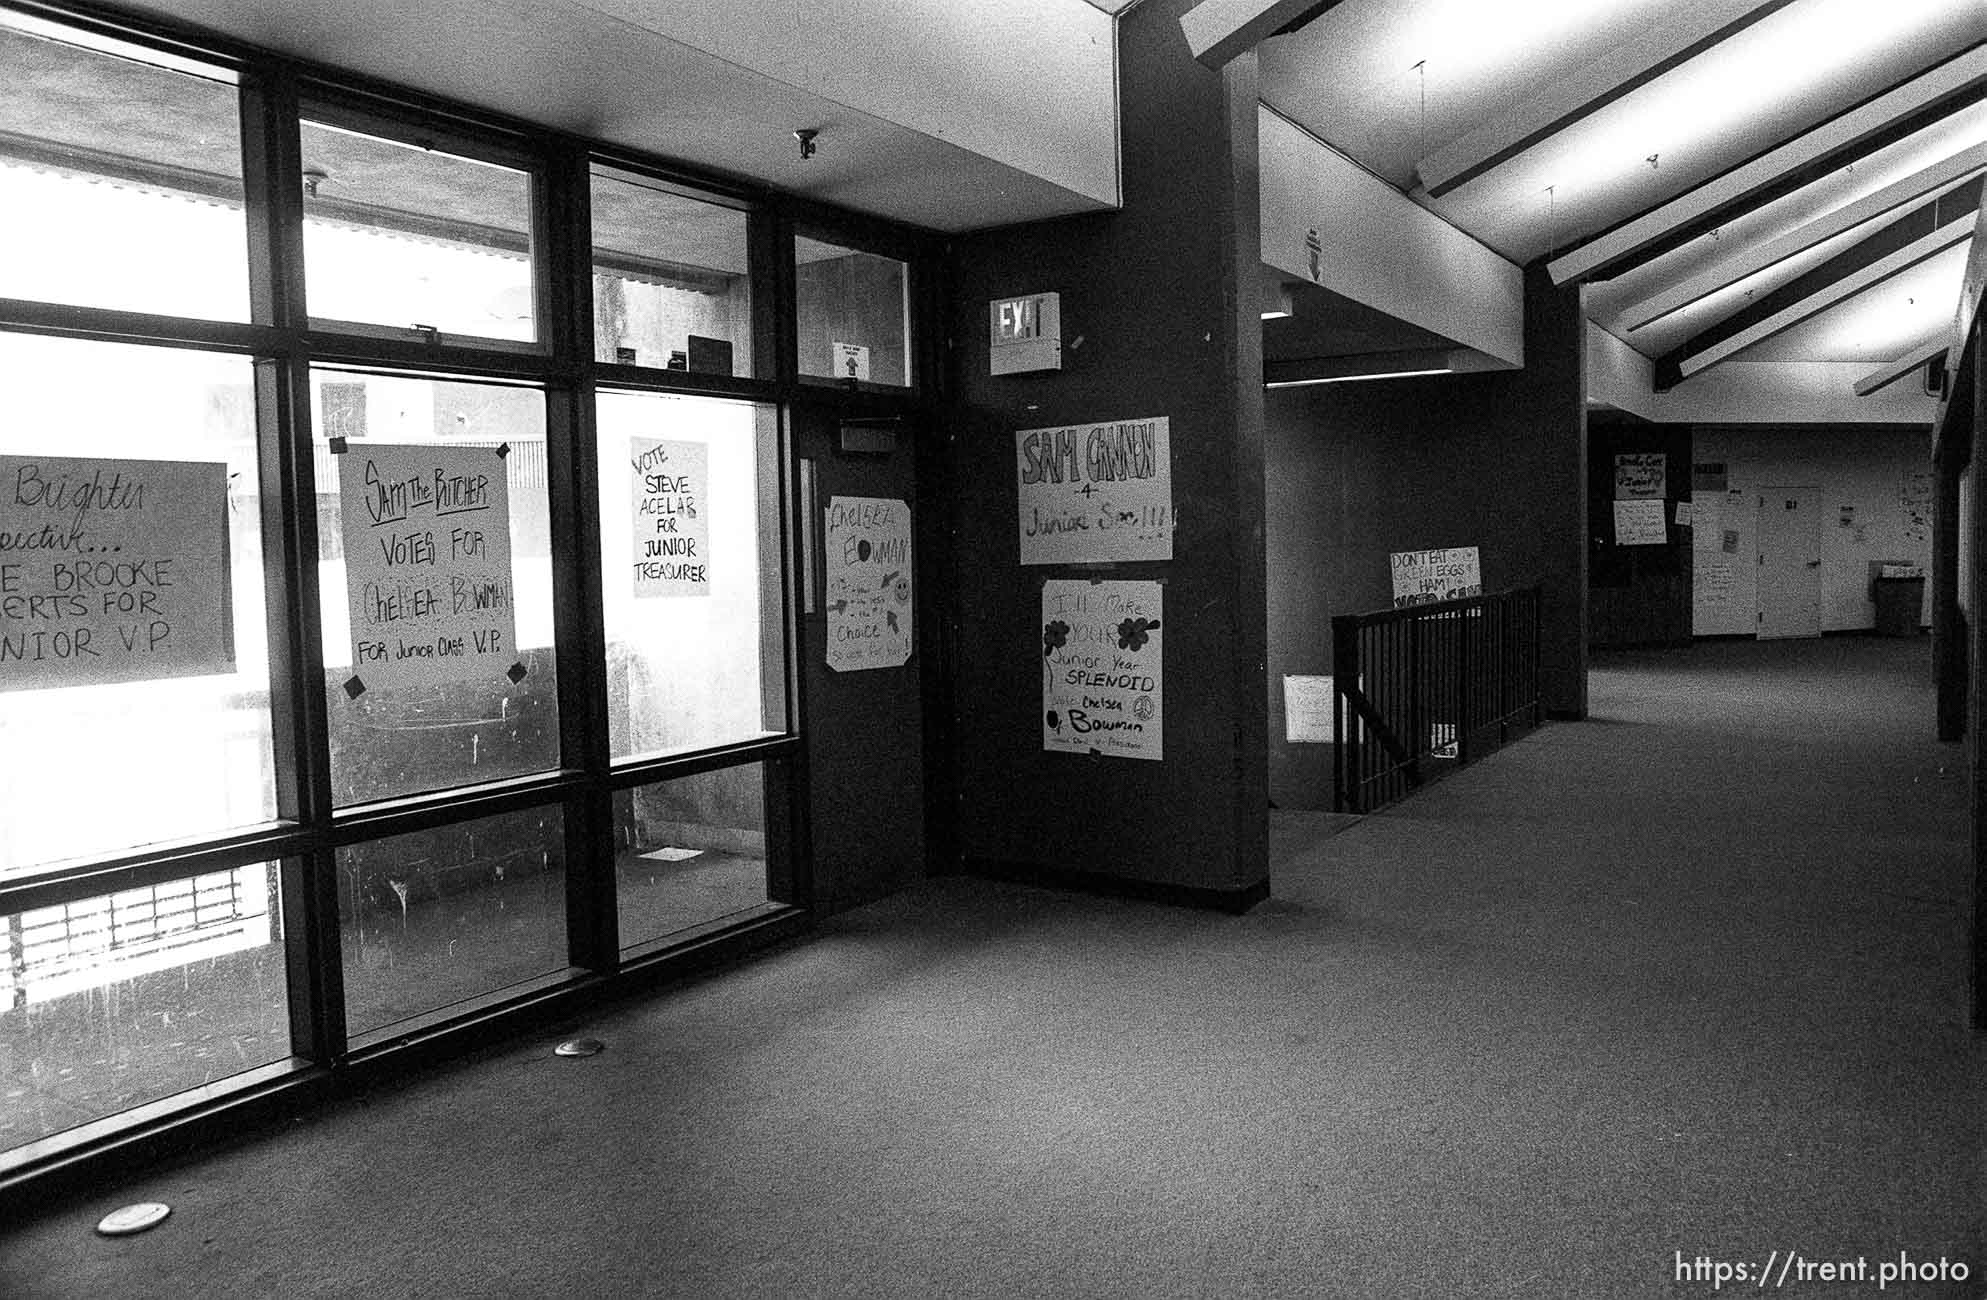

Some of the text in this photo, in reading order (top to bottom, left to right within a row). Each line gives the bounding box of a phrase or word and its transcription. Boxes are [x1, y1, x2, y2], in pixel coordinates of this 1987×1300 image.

[999, 297, 1046, 340] EXIT
[631, 443, 669, 475] VOTE
[1022, 429, 1081, 485] SAM
[645, 474, 692, 493] STEVE
[14, 464, 144, 541] Brighter
[657, 517, 678, 534] FOR
[380, 528, 486, 566] VOTES FOR
[644, 537, 697, 558] JUNIOR
[53, 559, 173, 592] BROOKE
[633, 561, 706, 583] TREASURER
[1436, 563, 1465, 577] EGGS
[0, 591, 163, 619] ERTS FOR
[358, 641, 388, 664] FOR
[473, 629, 501, 654] V.P.
[1112, 654, 1141, 671] Year
[1065, 669, 1154, 692] SPLENDID
[1082, 696, 1122, 711] Chelsea
[1068, 709, 1143, 734] Bowman
